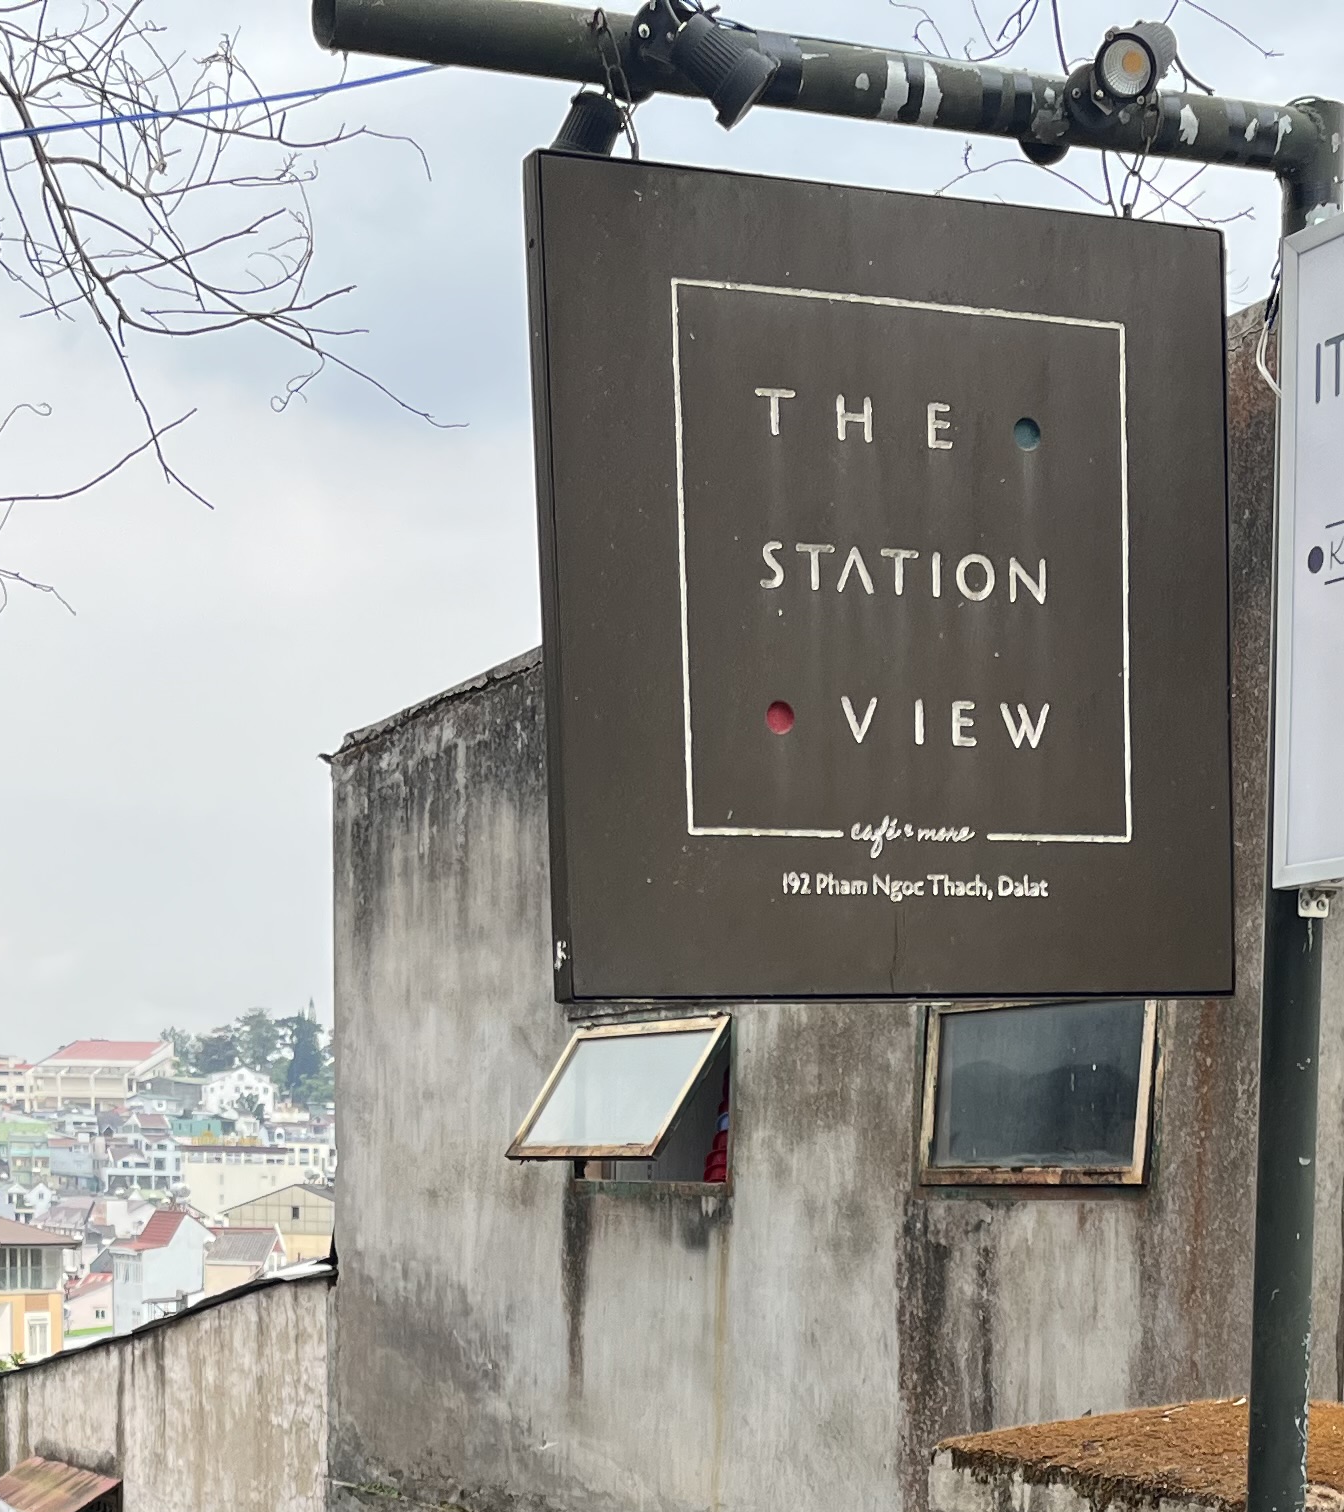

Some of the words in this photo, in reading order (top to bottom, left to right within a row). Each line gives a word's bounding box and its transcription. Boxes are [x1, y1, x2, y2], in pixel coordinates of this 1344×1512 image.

[754, 388, 953, 450] THE
[759, 541, 1047, 605] STATION
[840, 696, 1050, 749] VIEW
[917, 826, 976, 842] more
[782, 871, 812, 896] 192
[816, 872, 868, 896] Pham
[872, 873, 925, 902] Ngoc
[926, 873, 994, 901] Thach,
[997, 873, 1049, 898] Dalat
